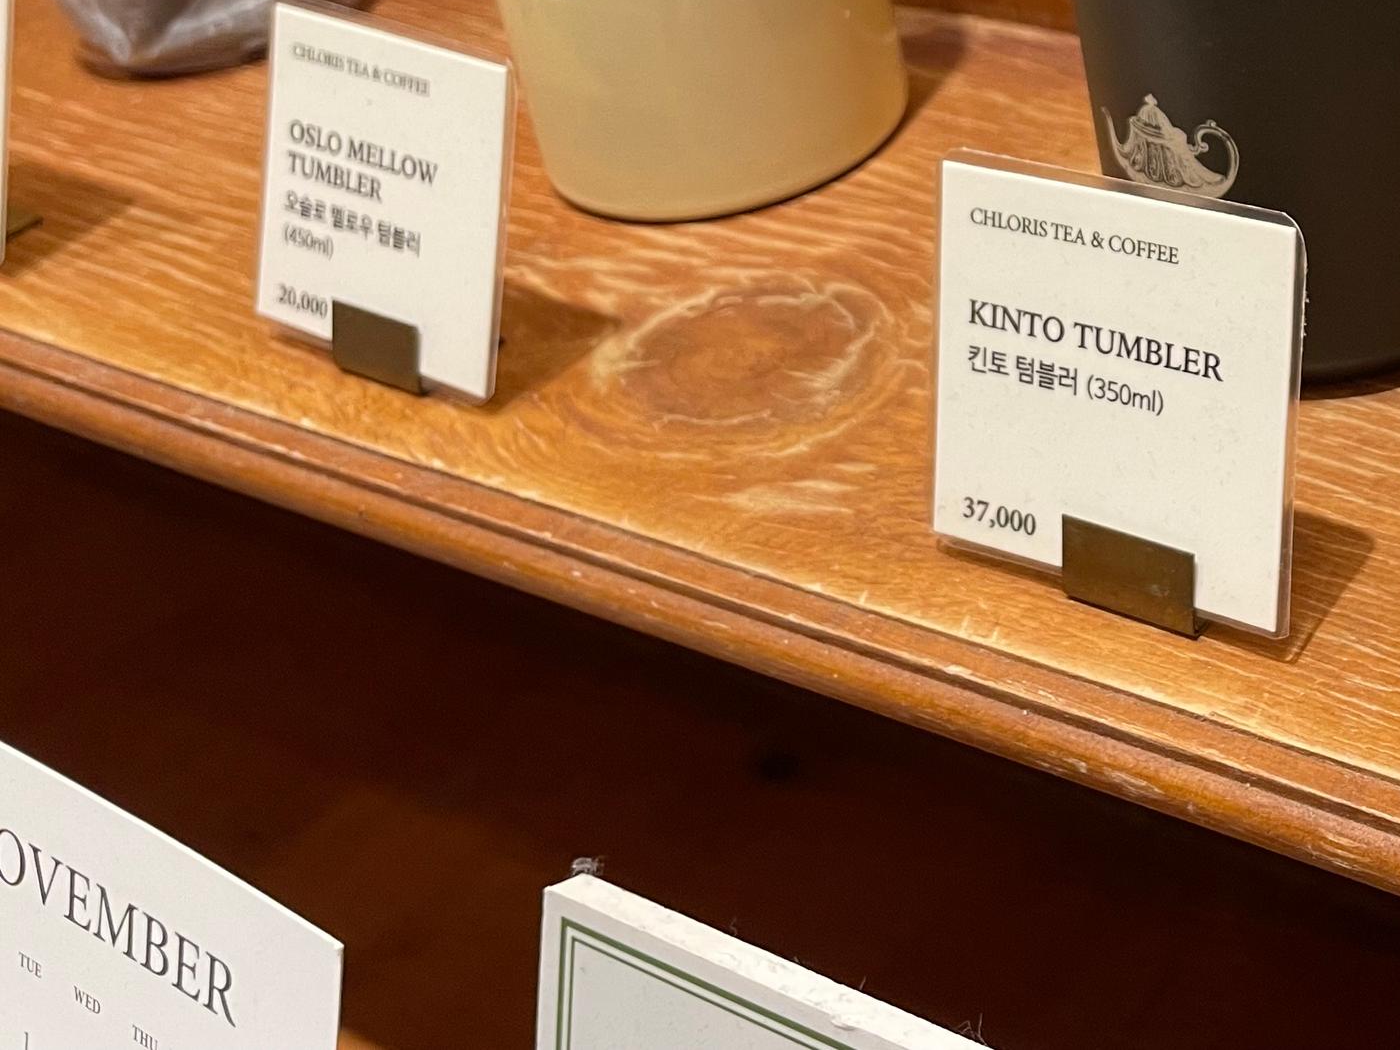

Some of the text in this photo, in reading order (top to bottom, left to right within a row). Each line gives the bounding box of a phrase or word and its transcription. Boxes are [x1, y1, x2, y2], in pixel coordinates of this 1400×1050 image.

[292, 41, 431, 97] CHLORIS TEA & COFFEE
[287, 150, 384, 202] TUMBLER
[290, 119, 439, 187] OSLO MELLOW
[283, 224, 335, 260] (450ml)
[970, 207, 1180, 265] CHLORIS TEA & COFFEE
[278, 283, 329, 320] 20,000
[968, 299, 1224, 383] KINTO TUMBLER
[967, 345, 1164, 417] 킨토 텀블러 (350ml)
[962, 496, 1036, 536] 37,000
[18, 951, 158, 1050] TUE WED THU
